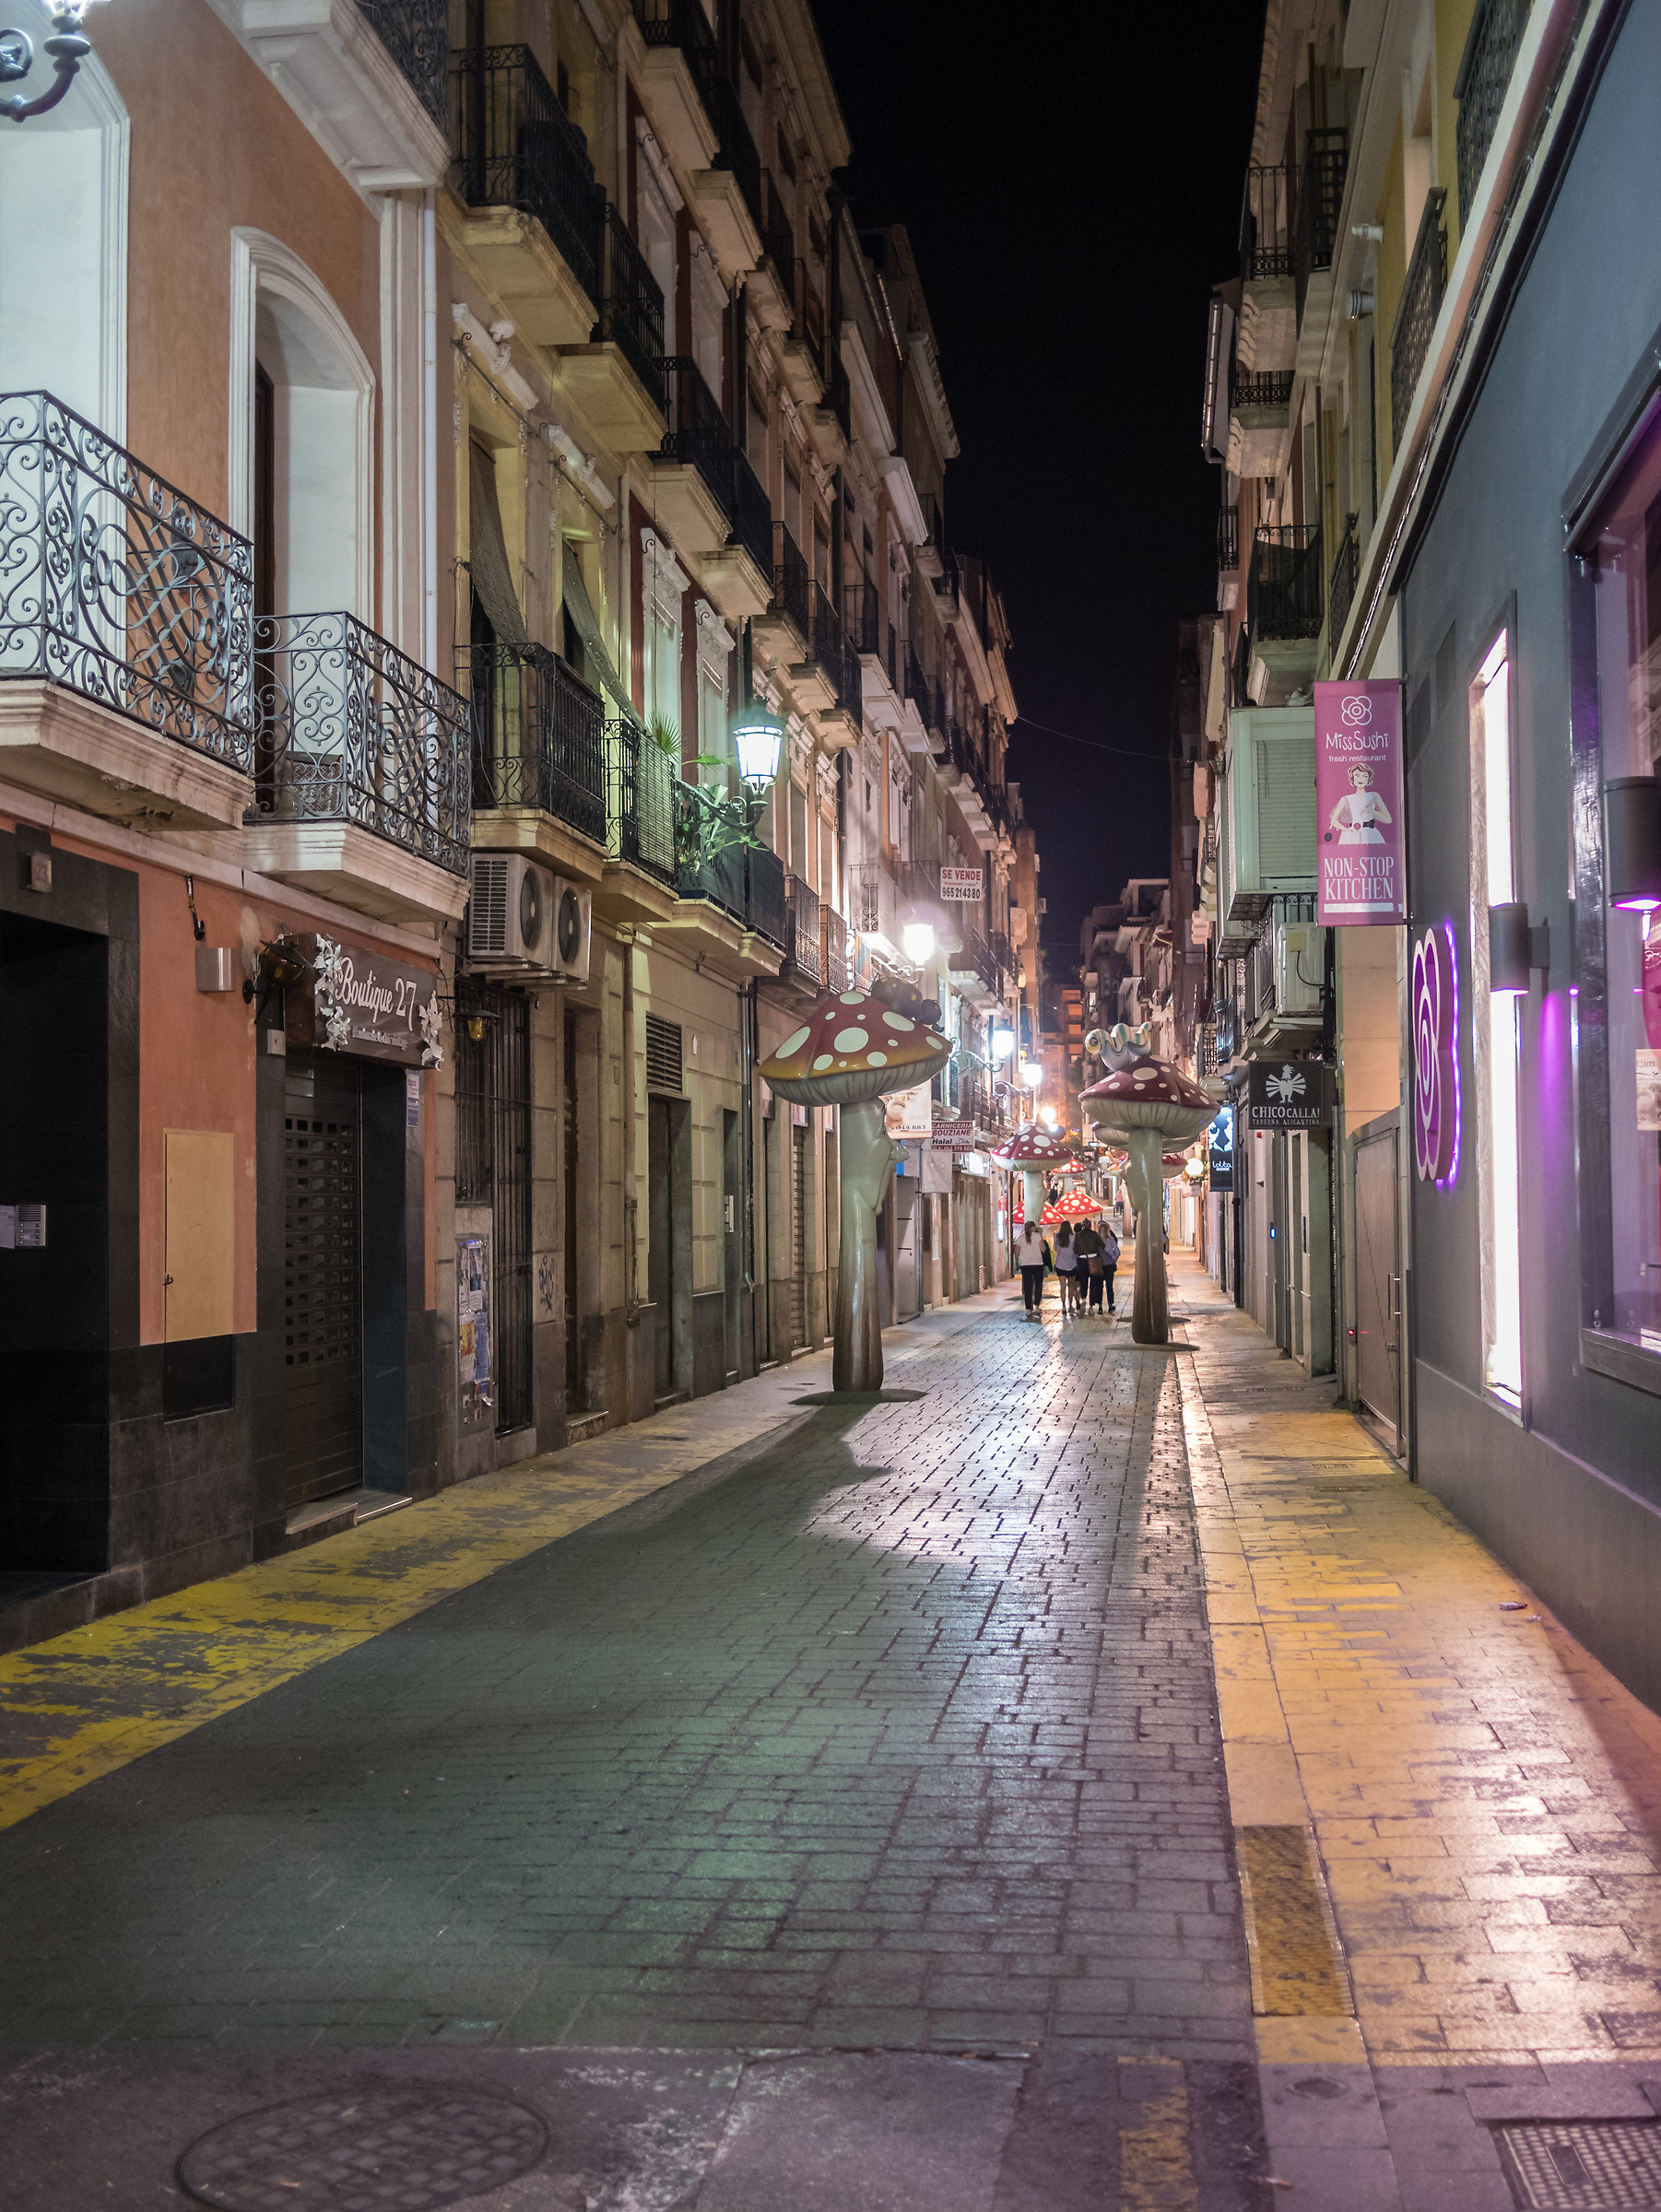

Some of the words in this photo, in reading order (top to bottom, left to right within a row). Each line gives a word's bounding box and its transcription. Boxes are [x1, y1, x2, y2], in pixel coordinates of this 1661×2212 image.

[1328, 755, 1348, 763] fresh
[1349, 754, 1387, 762] restaurant
[942, 869, 952, 879] SE
[955, 870, 982, 880] VENDE
[1324, 856, 1395, 877] NON-STOP
[1325, 877, 1394, 900] KITCHEN
[335, 956, 394, 1024] Boutique
[395, 977, 418, 1032] 27
